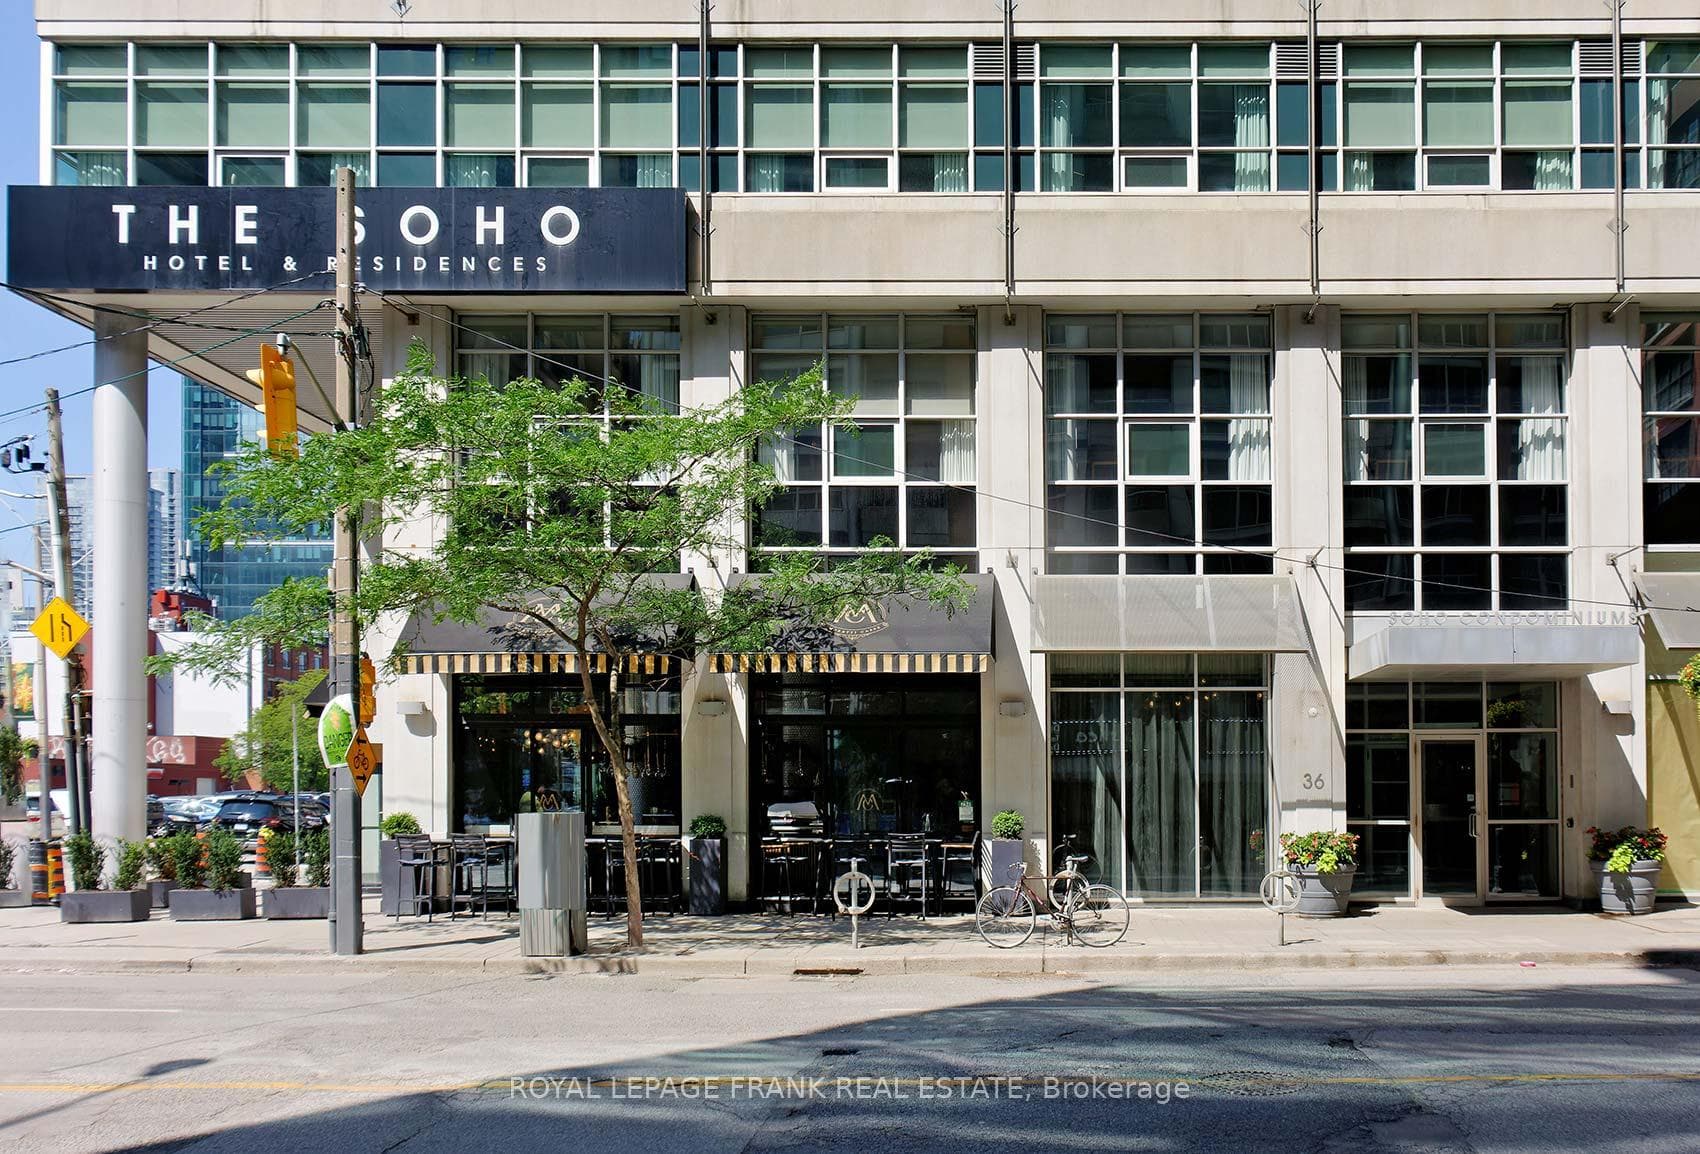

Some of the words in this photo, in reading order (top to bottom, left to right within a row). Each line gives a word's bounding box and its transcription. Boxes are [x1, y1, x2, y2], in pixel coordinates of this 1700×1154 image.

[112, 204, 259, 244] THE
[143, 255, 252, 271] HOTEL
[283, 255, 297, 271] &
[1389, 611, 1447, 625] SOHO
[1459, 610, 1638, 625] CONDOMINIUMS
[1303, 773, 1325, 790] 36
